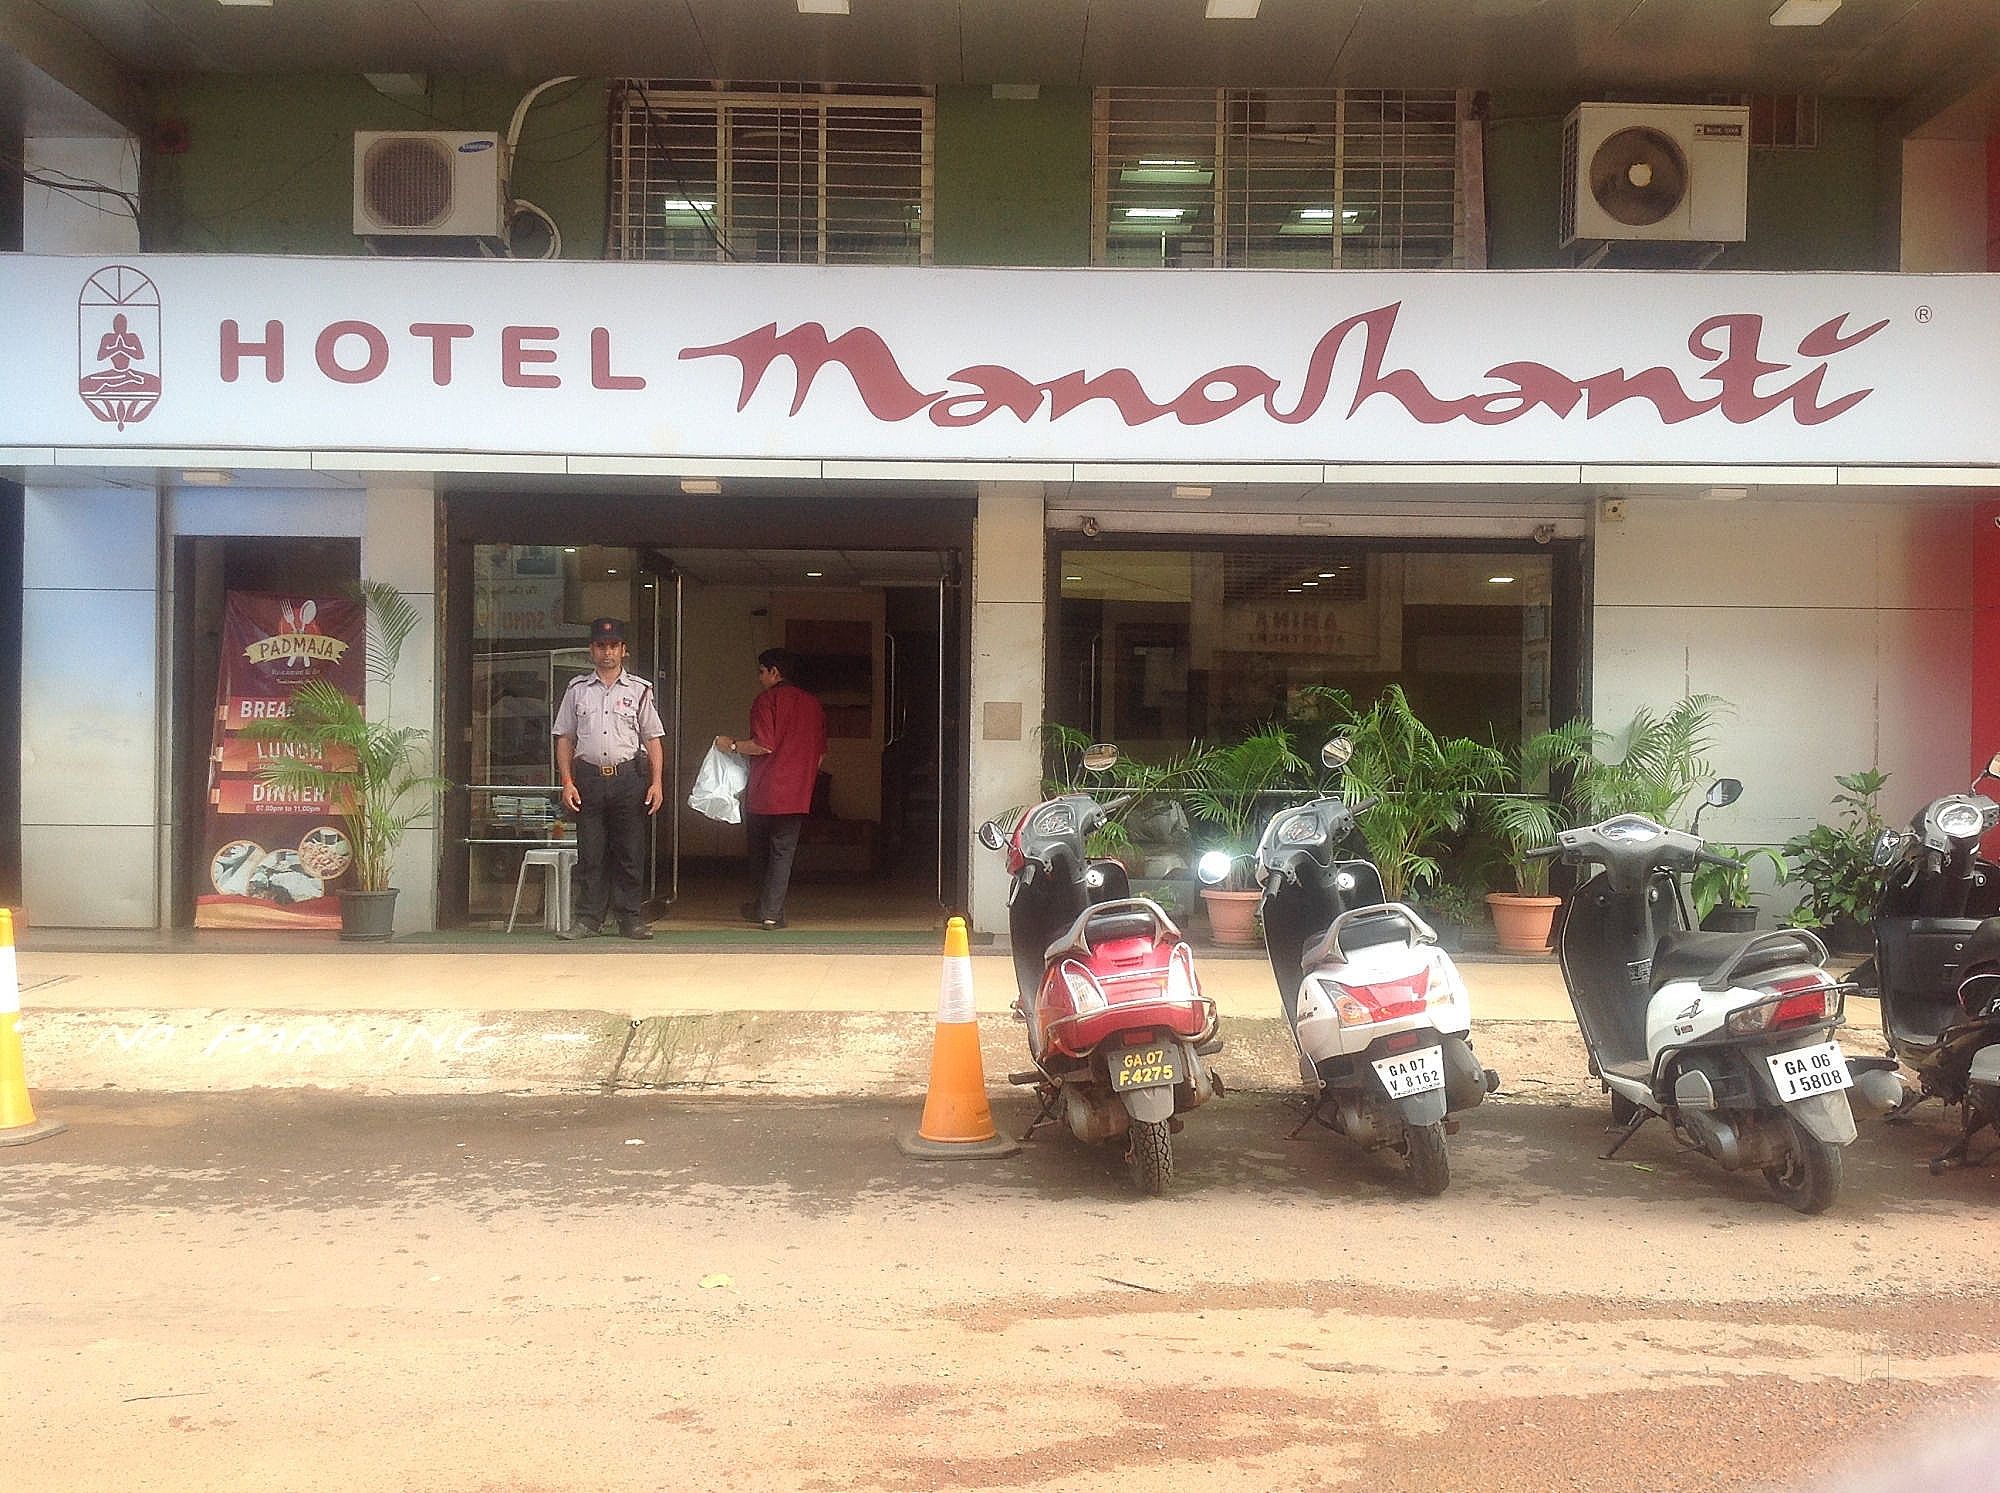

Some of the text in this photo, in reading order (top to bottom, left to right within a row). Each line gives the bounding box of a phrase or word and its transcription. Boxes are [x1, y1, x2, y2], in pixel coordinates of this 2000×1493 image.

[220, 319, 647, 391] HOTEL
[260, 637, 334, 658] PADMAJA
[252, 784, 325, 801] DINNER
[285, 804, 292, 812] to
[1784, 1054, 1830, 1075] GA 06
[1390, 1080, 1398, 1091] V
[1405, 1070, 1440, 1087] 8162
[1789, 1070, 1843, 1095] J 5808
